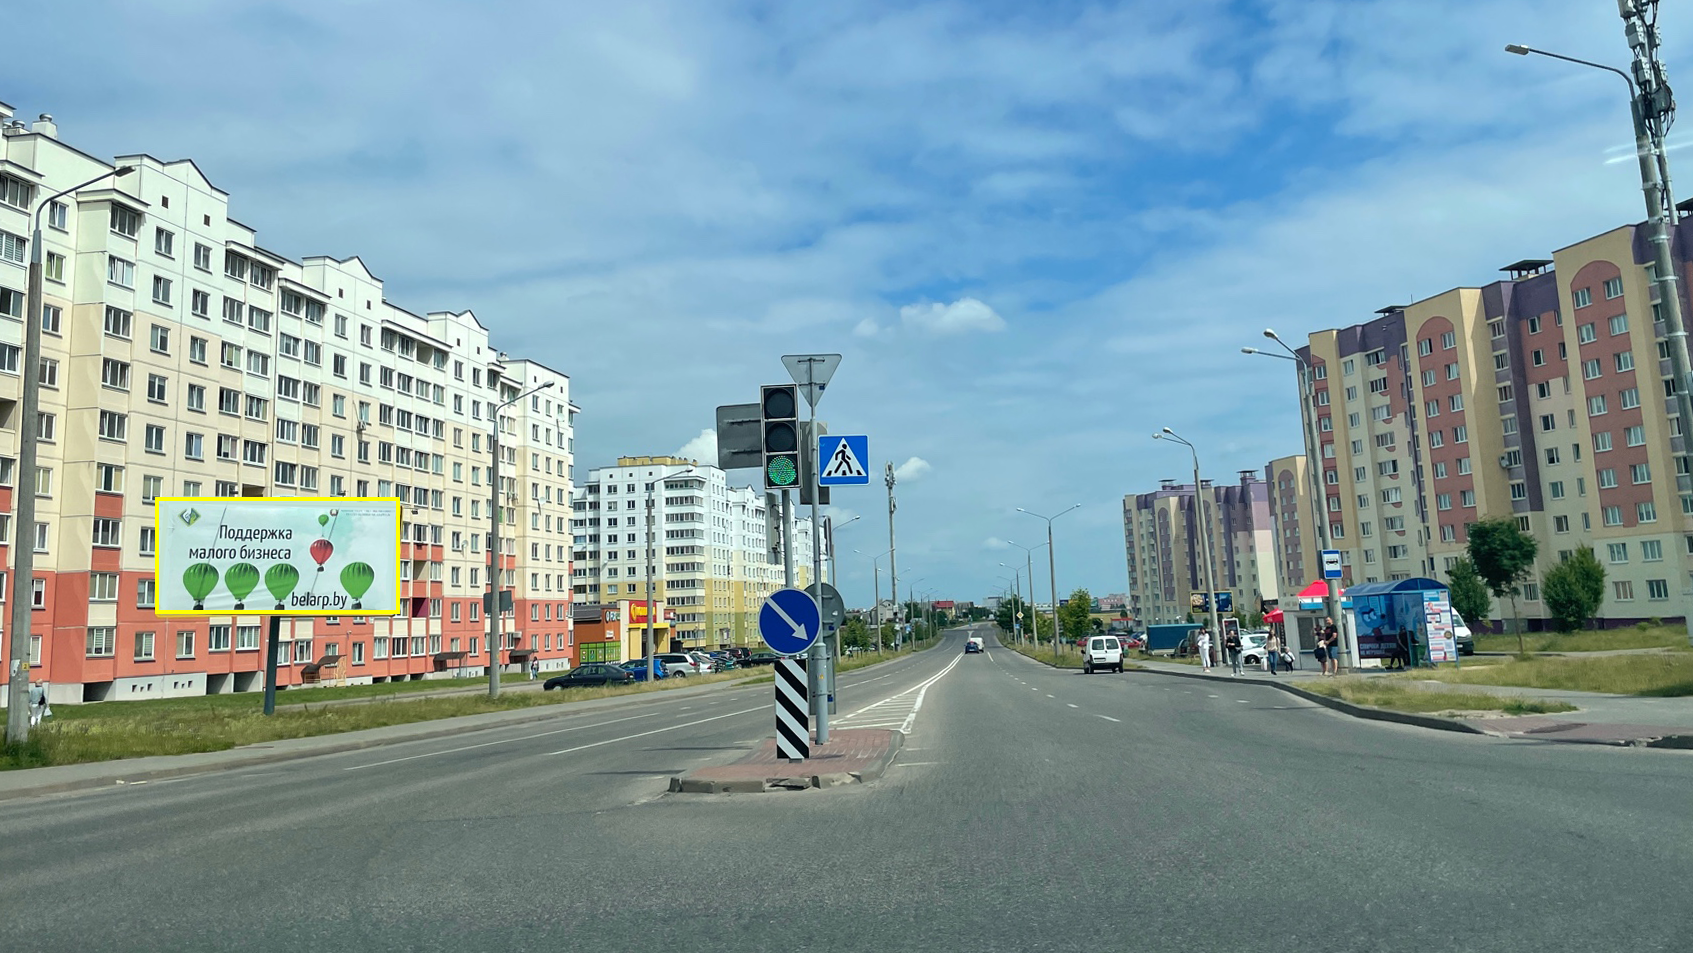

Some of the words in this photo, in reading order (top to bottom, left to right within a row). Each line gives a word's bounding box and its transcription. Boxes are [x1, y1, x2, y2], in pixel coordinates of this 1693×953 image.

[219, 524, 293, 543] Поддержка
[188, 547, 237, 560] малого
[239, 544, 292, 560] бизнеса
[291, 590, 348, 610] belarp.by
